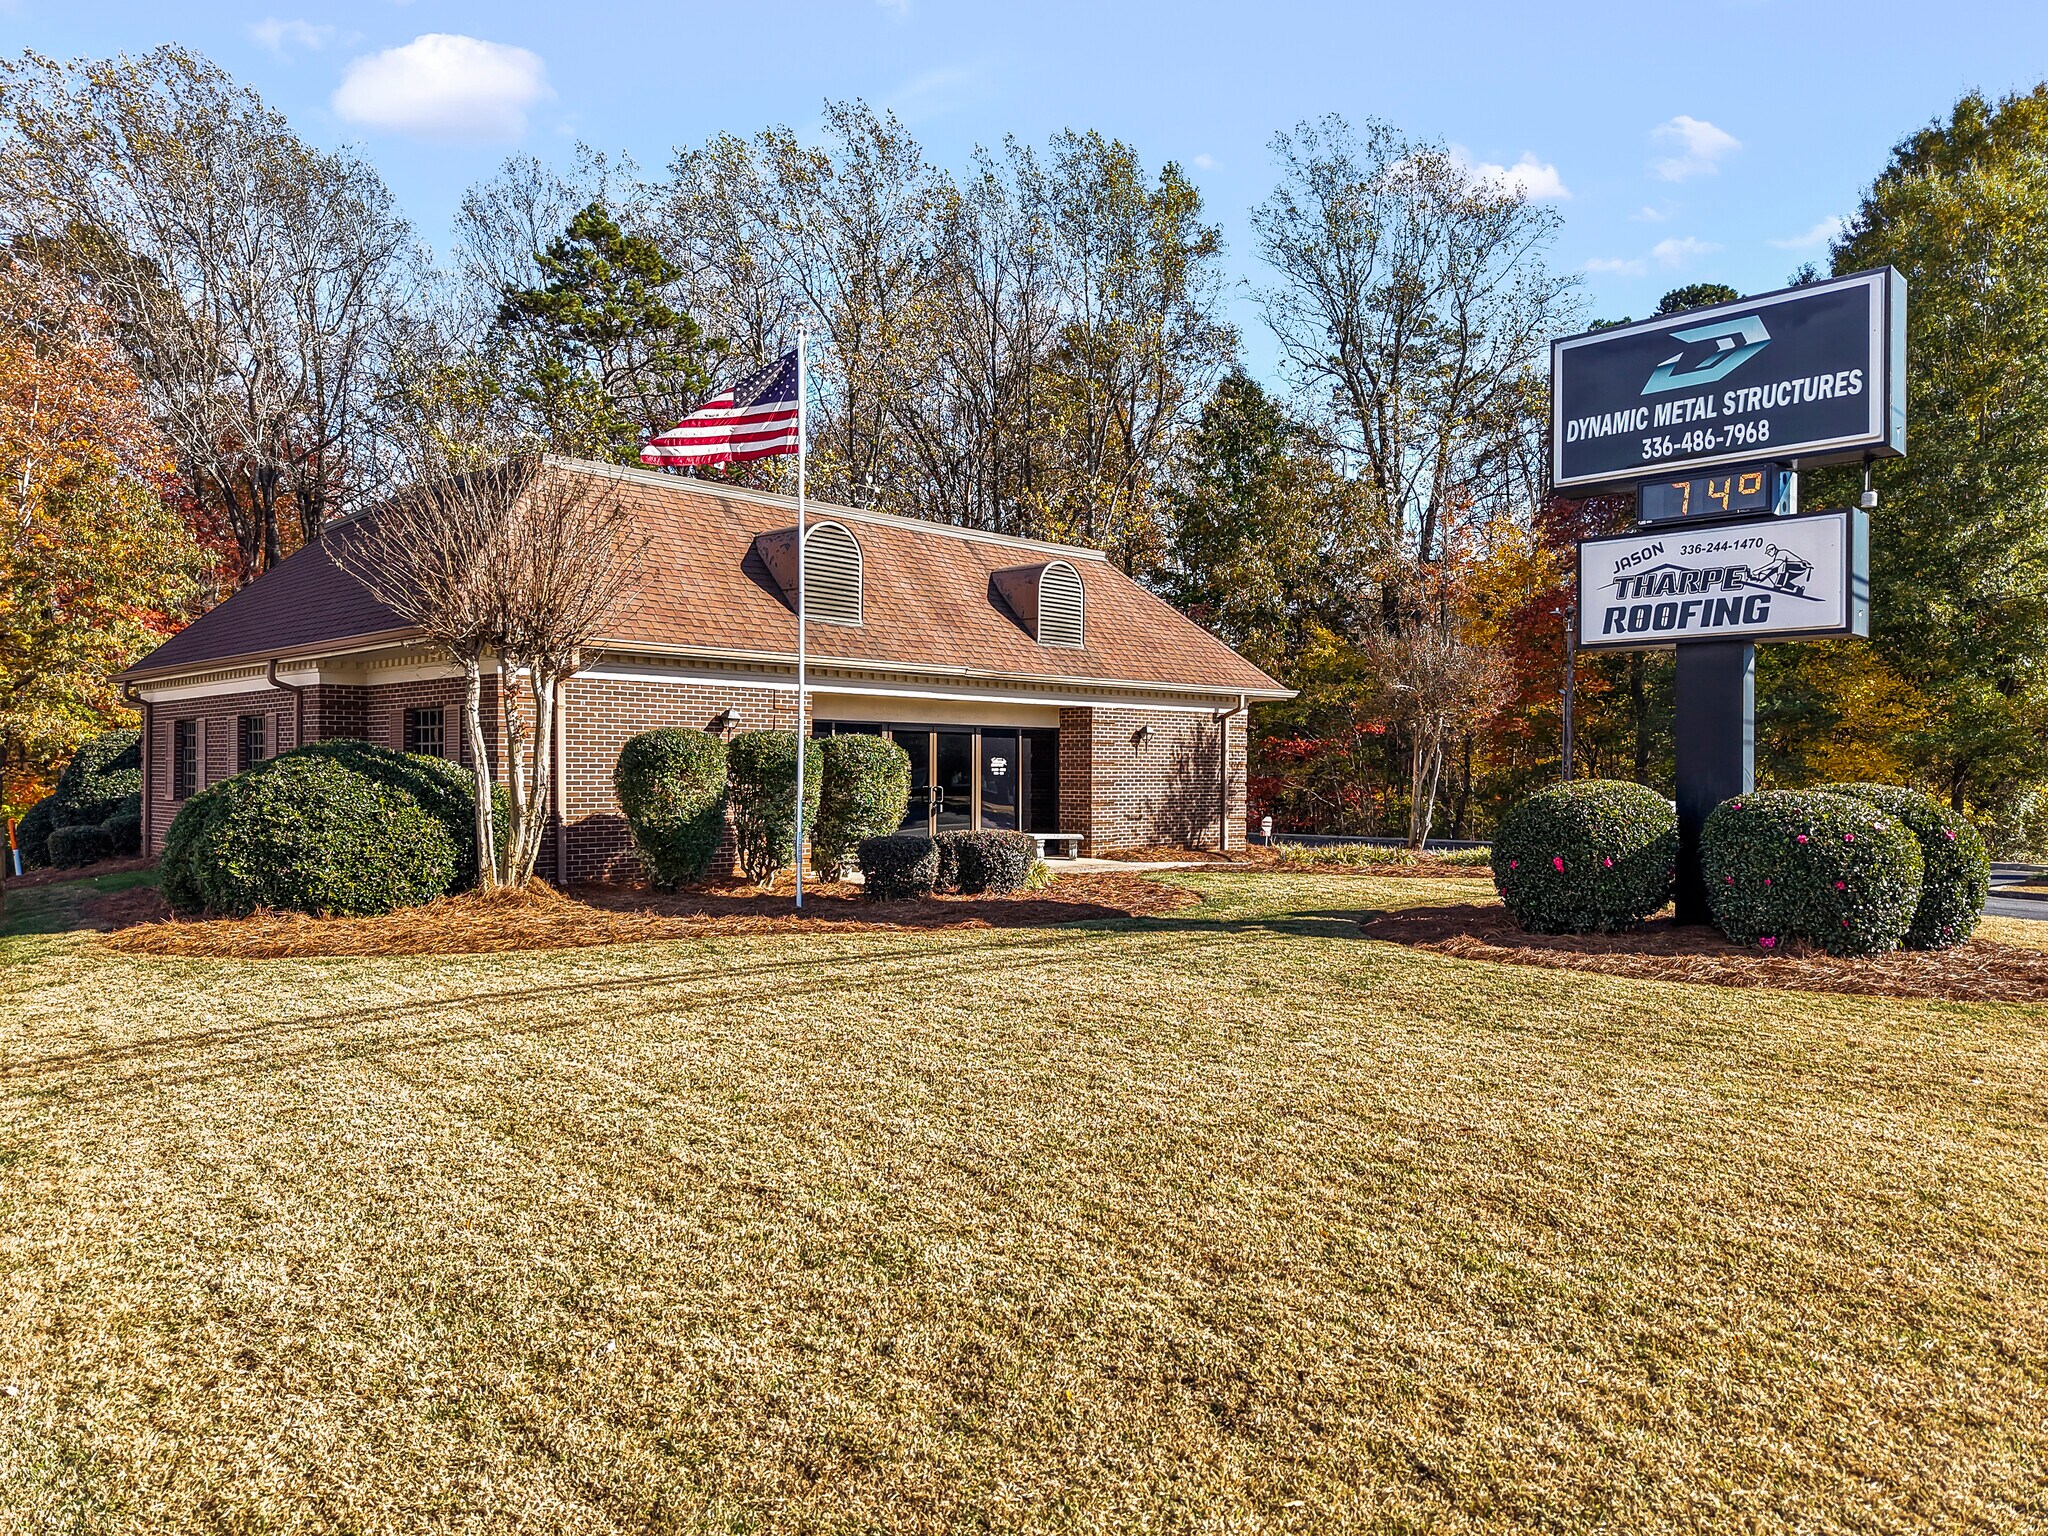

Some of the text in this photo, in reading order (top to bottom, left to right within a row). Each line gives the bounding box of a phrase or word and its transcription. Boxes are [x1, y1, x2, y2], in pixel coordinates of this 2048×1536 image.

[1566, 368, 1863, 443] DYNAMIC METAL STRUCTURES
[1641, 419, 1770, 459] 336-486-7968
[1613, 541, 1665, 574] JASON
[1680, 537, 1764, 556] 336-244-1470
[1613, 564, 1748, 600] THARPE
[1602, 594, 1772, 635] ROOFING
